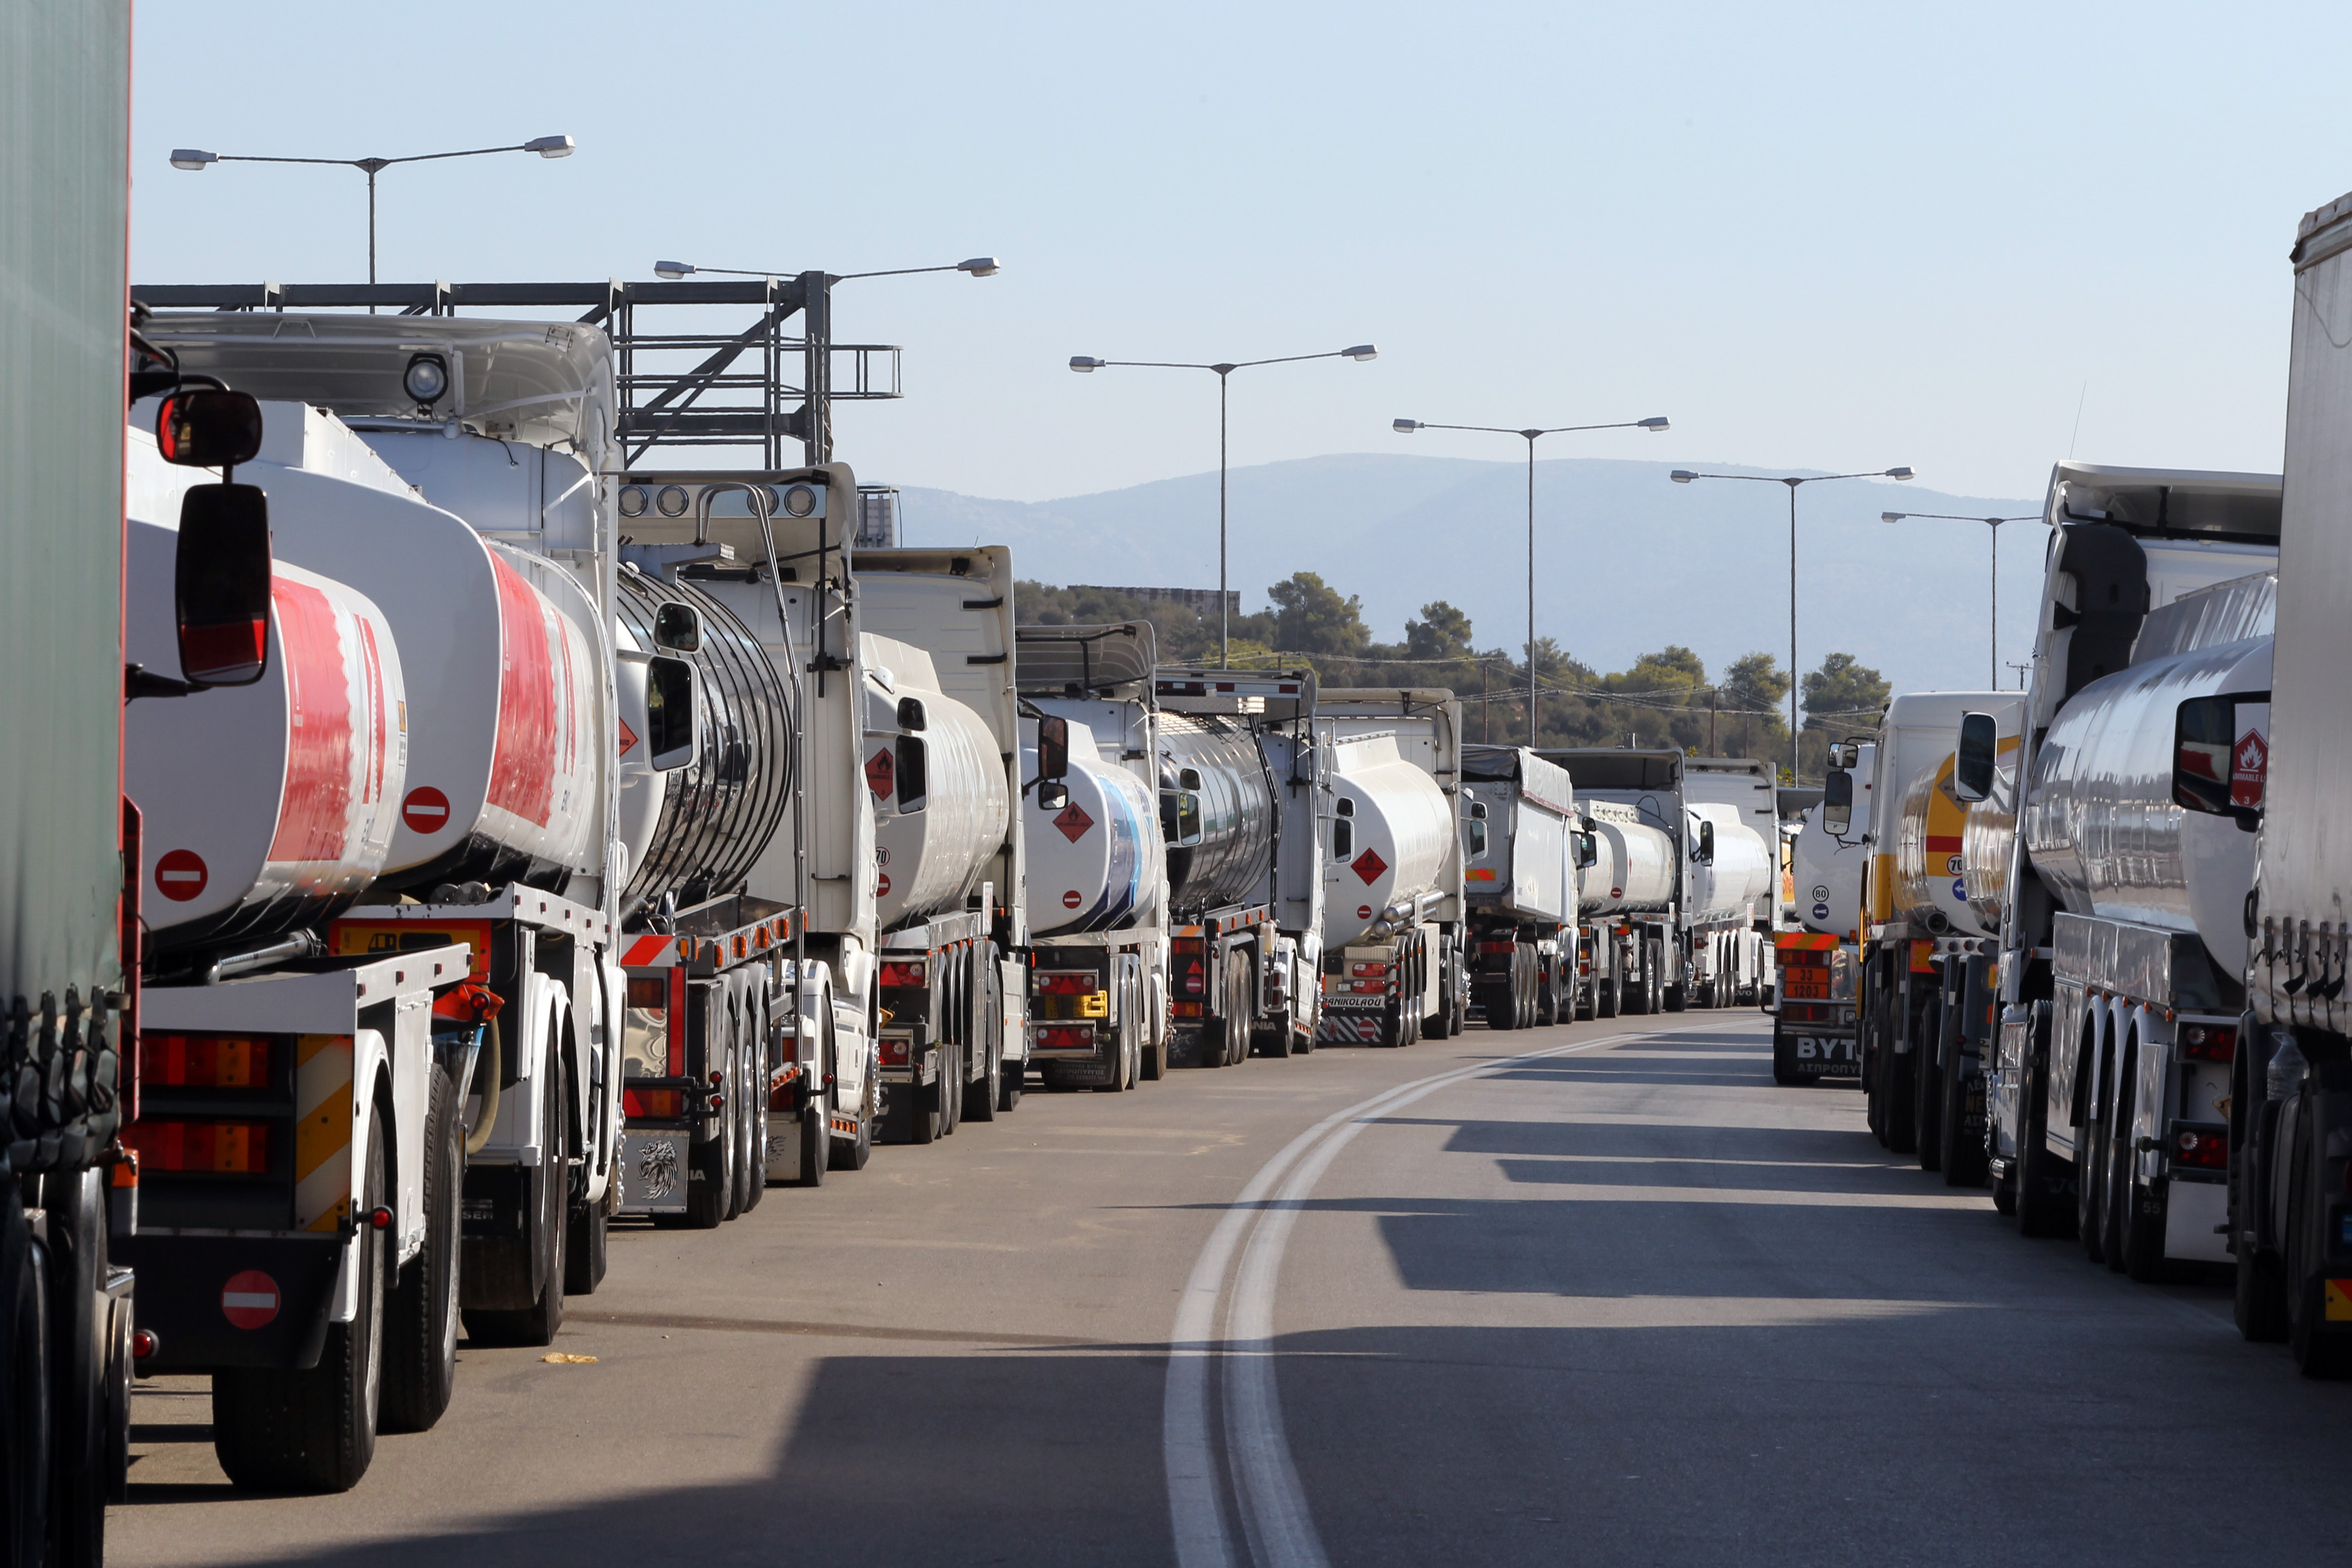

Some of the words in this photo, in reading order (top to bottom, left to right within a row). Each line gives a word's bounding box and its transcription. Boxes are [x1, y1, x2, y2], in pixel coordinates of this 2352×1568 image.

[2244, 796, 2250, 805] 3
[876, 850, 887, 864] 70
[1950, 860, 1962, 871] 70
[1816, 890, 1826, 898] 80
[1800, 969, 1813, 981] 33
[1794, 985, 1819, 998] 1203
